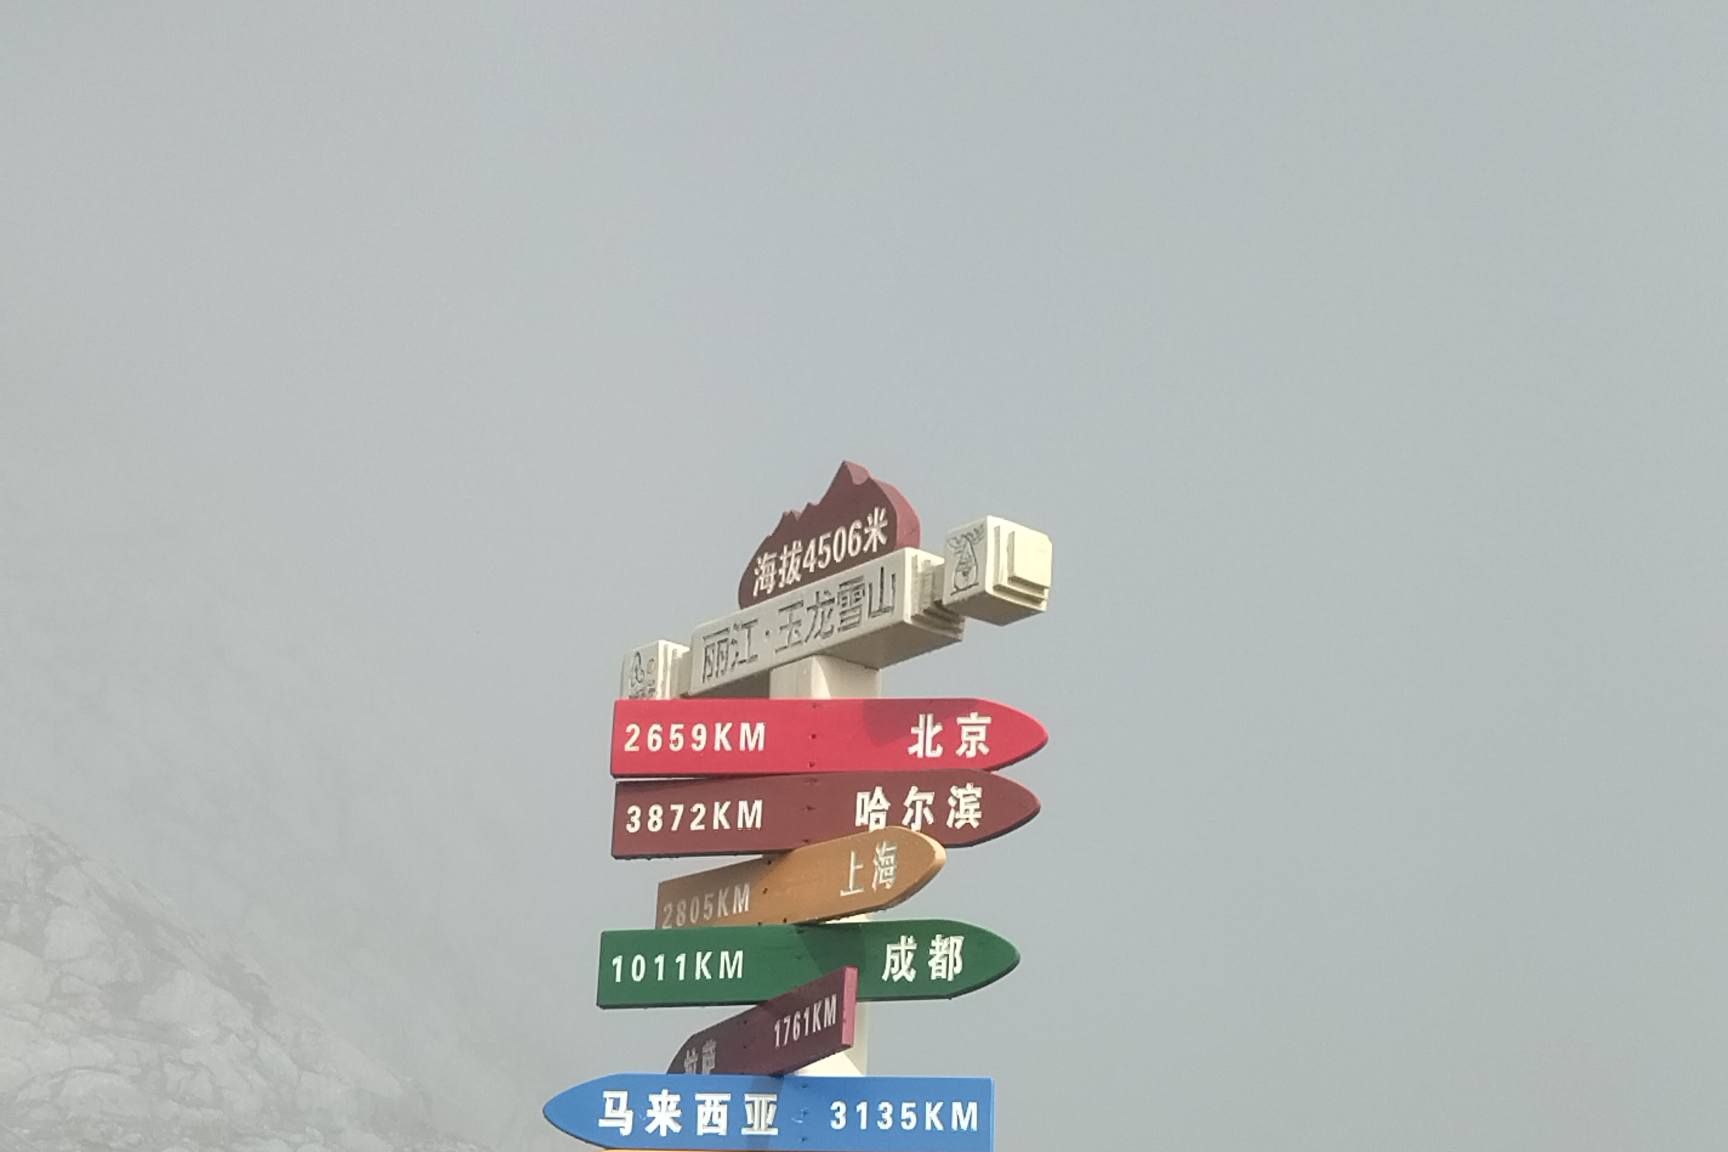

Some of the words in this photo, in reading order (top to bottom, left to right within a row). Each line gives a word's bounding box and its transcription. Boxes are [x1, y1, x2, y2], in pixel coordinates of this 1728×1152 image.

[753, 507, 888, 597] 海拔4506米
[624, 722, 766, 752] 2659KM
[908, 712, 992, 758] 北京
[626, 800, 763, 833] 3872KM
[855, 783, 983, 831] 哈尔滨
[662, 883, 749, 929] 2805KM
[840, 841, 897, 897] 上海
[612, 951, 744, 982] 1011KM
[882, 935, 964, 982] 成都
[774, 993, 837, 1048] 1761KM
[599, 1089, 779, 1136] 马来西亚
[831, 1101, 978, 1132] 3135KM
